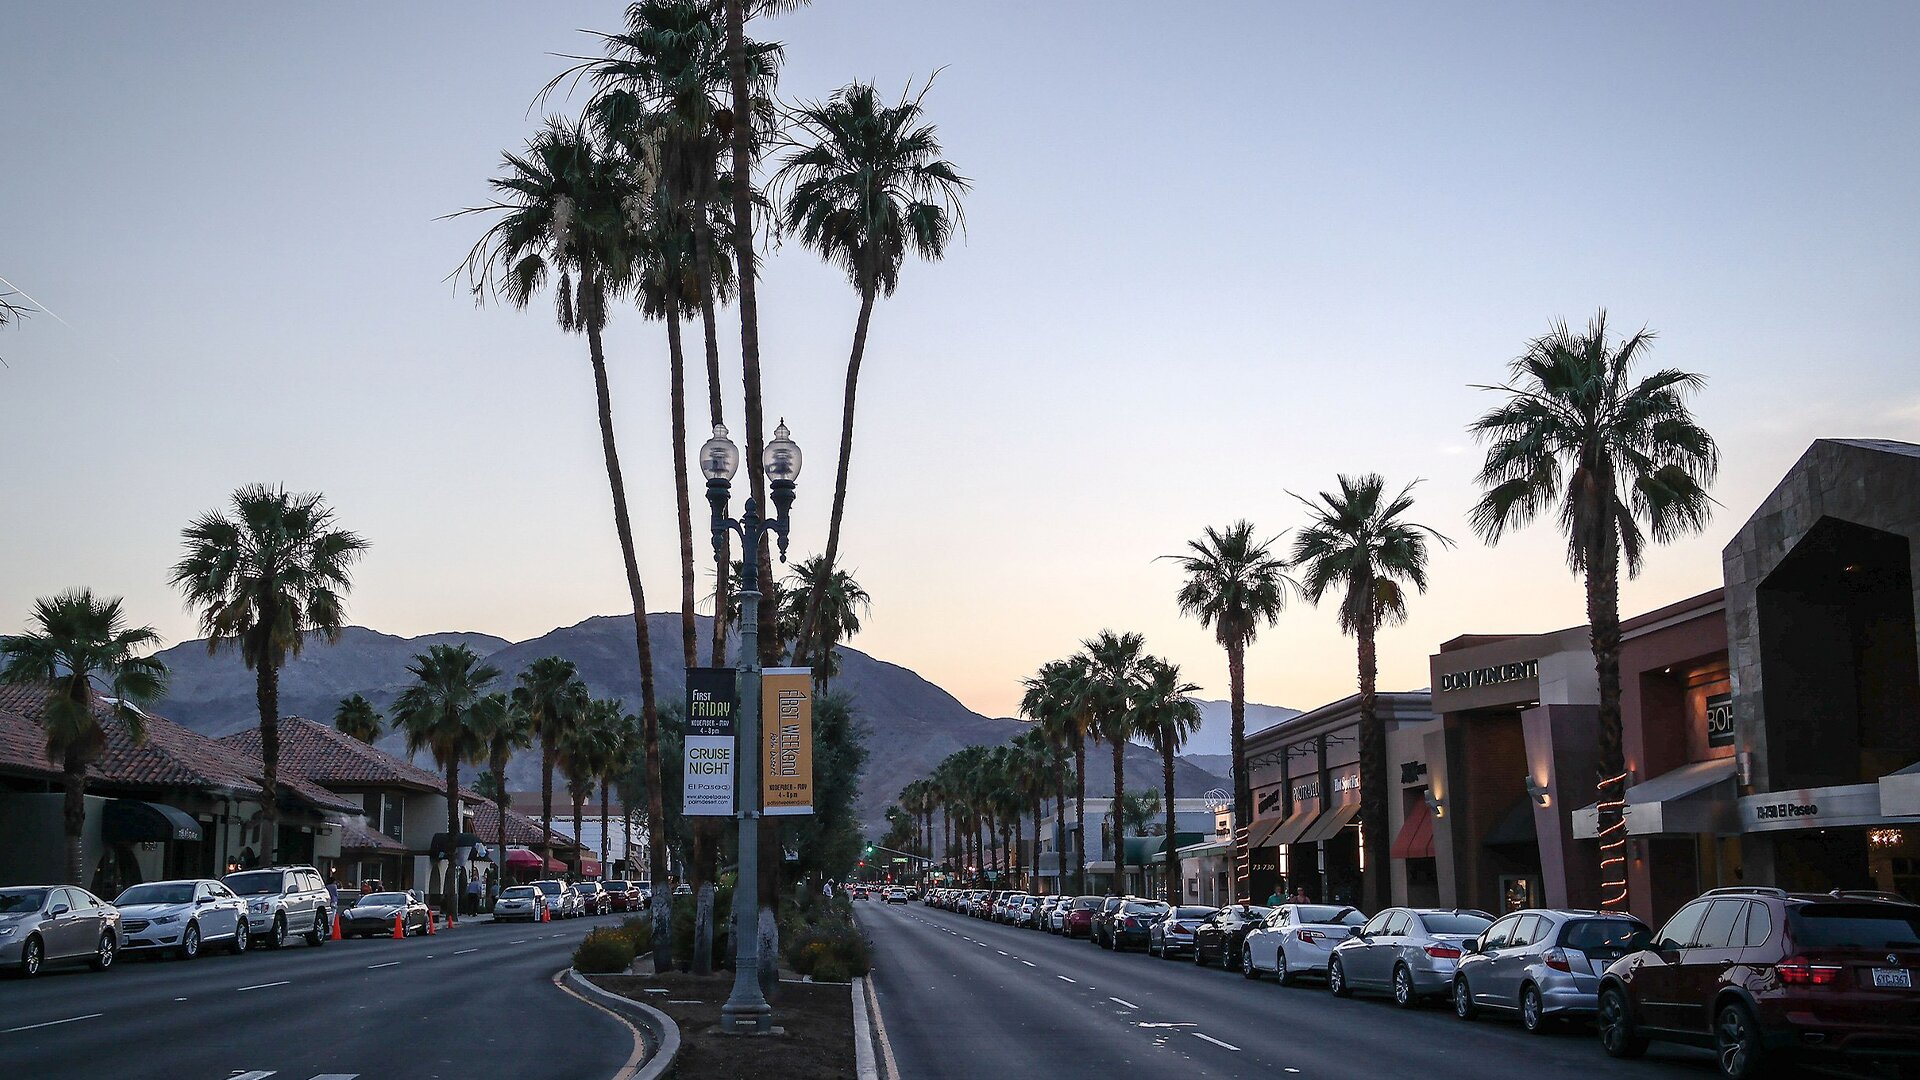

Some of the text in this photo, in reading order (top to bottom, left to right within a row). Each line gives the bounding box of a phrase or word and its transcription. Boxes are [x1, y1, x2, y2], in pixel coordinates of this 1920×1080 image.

[1442, 671, 1472, 691] DON
[691, 702, 730, 717] FRIDAY
[689, 748, 730, 759] CRUISE
[689, 762, 730, 774] NIGHT
[1787, 803, 1818, 816] Paseo
